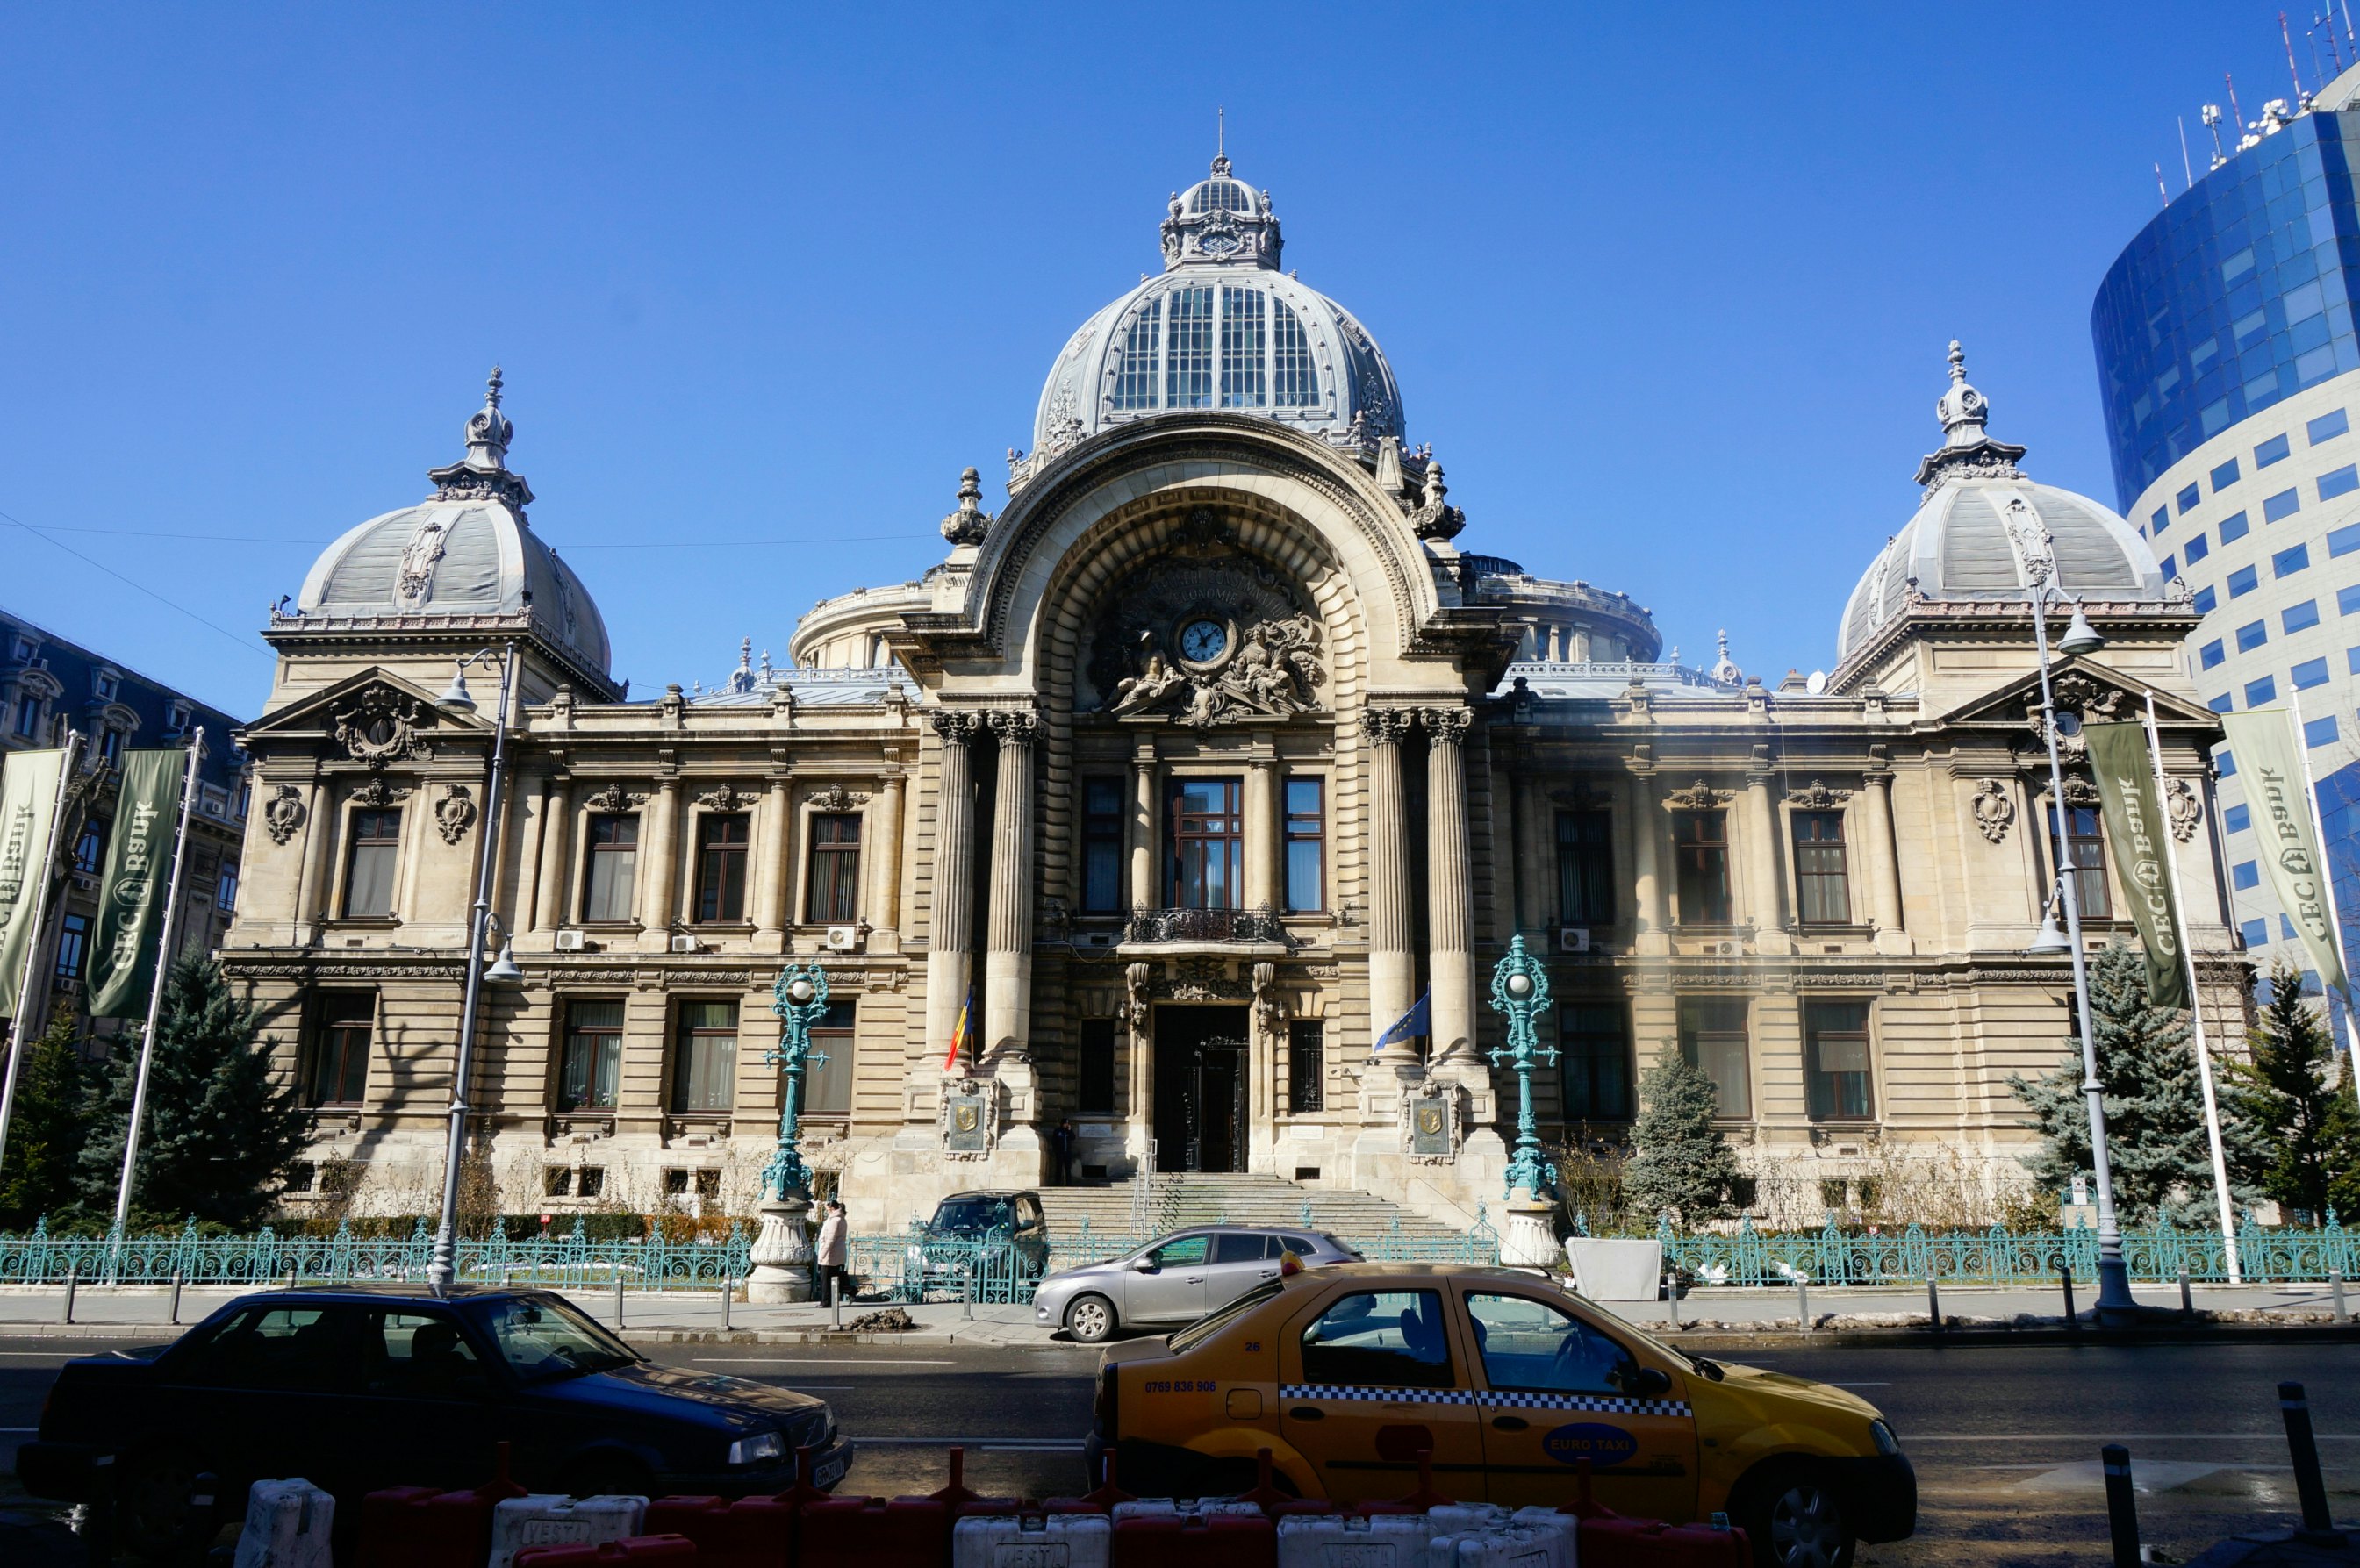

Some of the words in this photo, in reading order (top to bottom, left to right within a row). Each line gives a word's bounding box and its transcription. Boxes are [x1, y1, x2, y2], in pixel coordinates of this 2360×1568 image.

[1245, 1342, 1260, 1351] 26
[1145, 1381, 1171, 1393] 0769
[1174, 1381, 1194, 1393] 836
[1197, 1381, 1216, 1393] 906
[1550, 1439, 1591, 1450] EURO
[1596, 1439, 1630, 1450] TAXI
